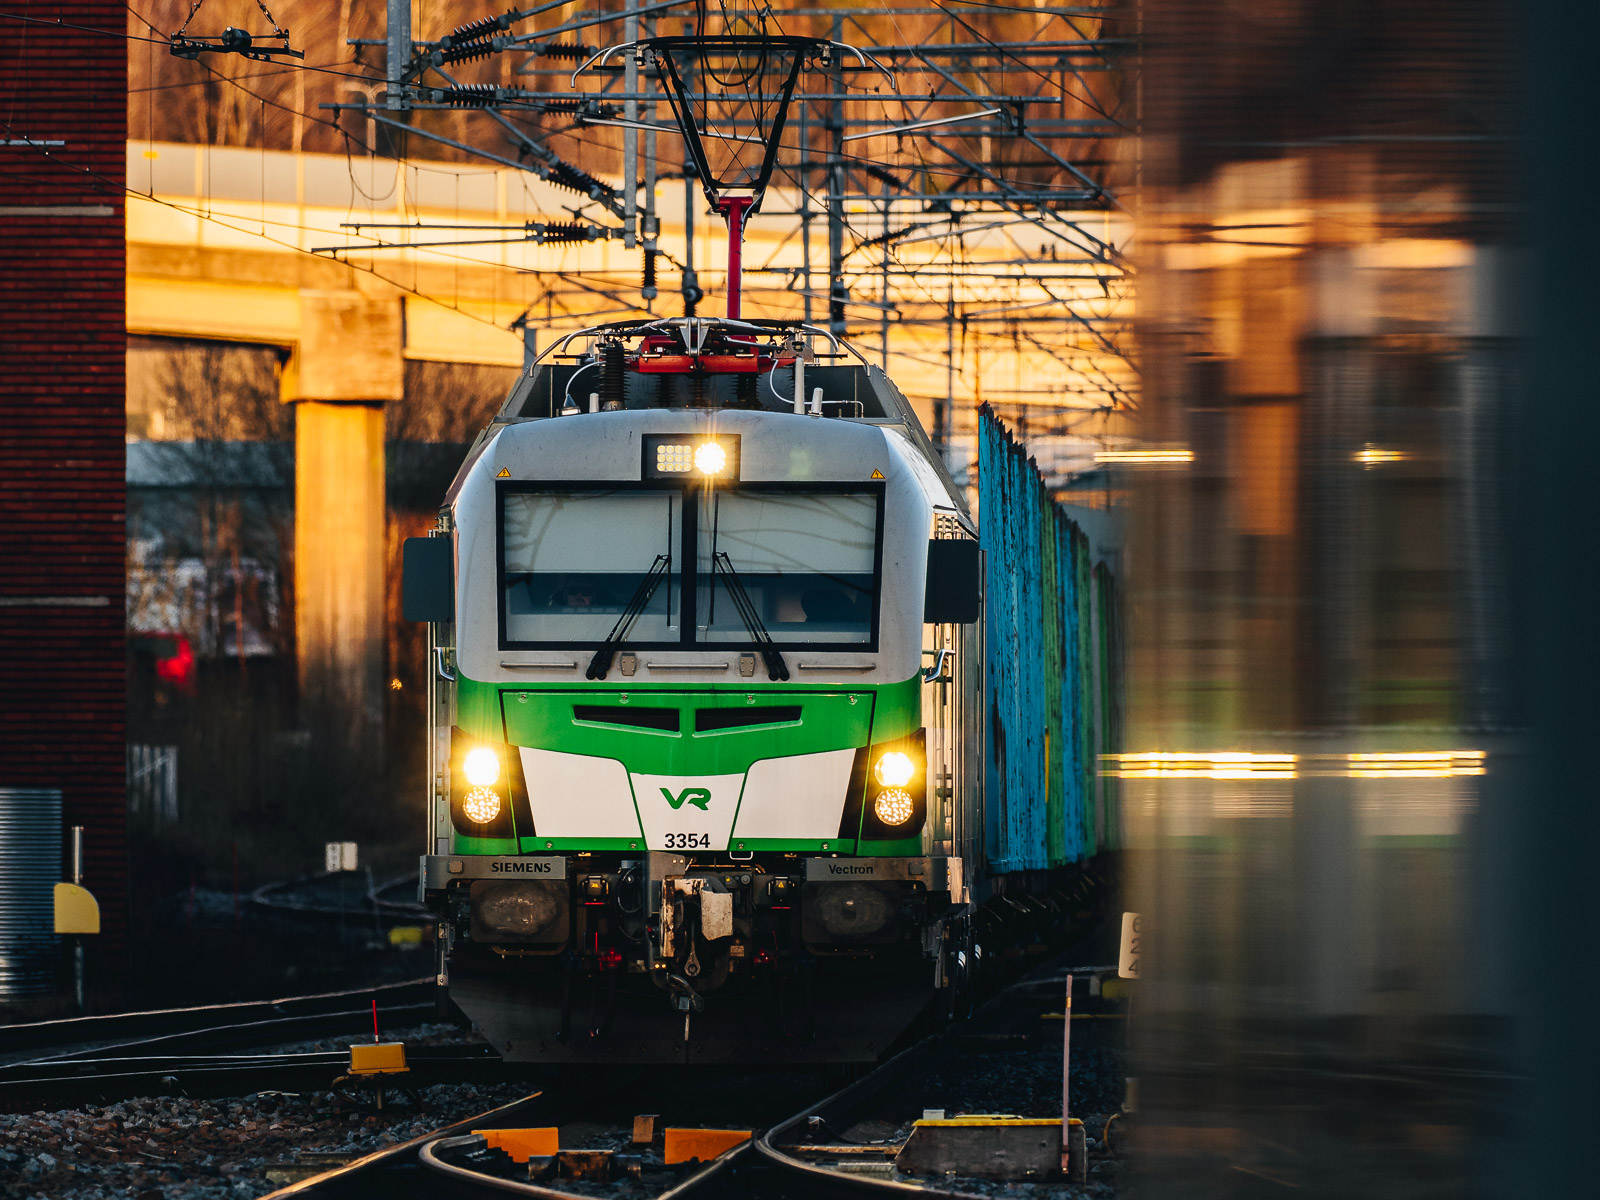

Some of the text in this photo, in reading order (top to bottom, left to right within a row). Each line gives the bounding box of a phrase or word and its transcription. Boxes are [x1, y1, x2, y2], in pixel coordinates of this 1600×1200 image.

[659, 788, 711, 811] VR
[664, 833, 711, 848] 3354
[491, 862, 551, 873] SIEMENS
[829, 864, 873, 874] Vectron
